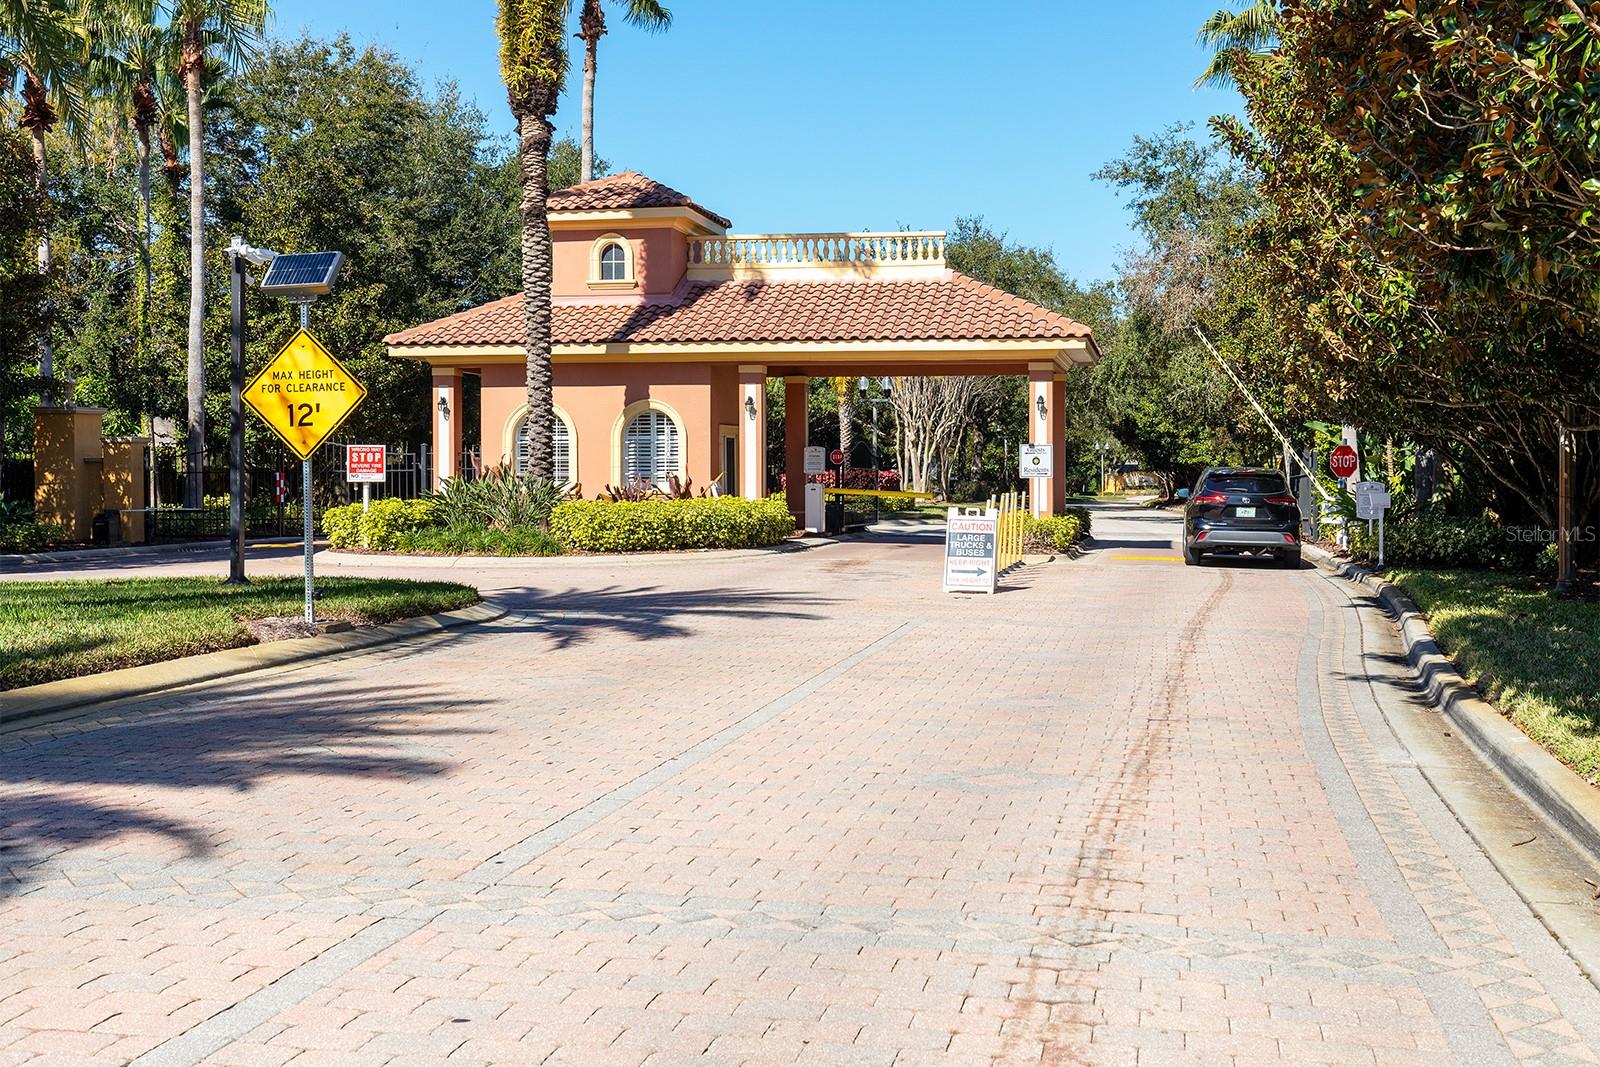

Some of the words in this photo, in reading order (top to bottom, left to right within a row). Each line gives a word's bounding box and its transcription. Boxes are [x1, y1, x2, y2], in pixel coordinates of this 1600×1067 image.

[272, 371, 293, 380] MAX
[298, 369, 334, 379] HEIGHT
[261, 384, 280, 393] FOR
[286, 382, 345, 393] CLEARANCE
[287, 403, 320, 427] 12'
[351, 452, 381, 463] STOP
[1331, 455, 1356, 468] STOP
[952, 523, 992, 531] CAUTION
[950, 541, 984, 549] TRUCKS
[985, 542, 993, 550] &
